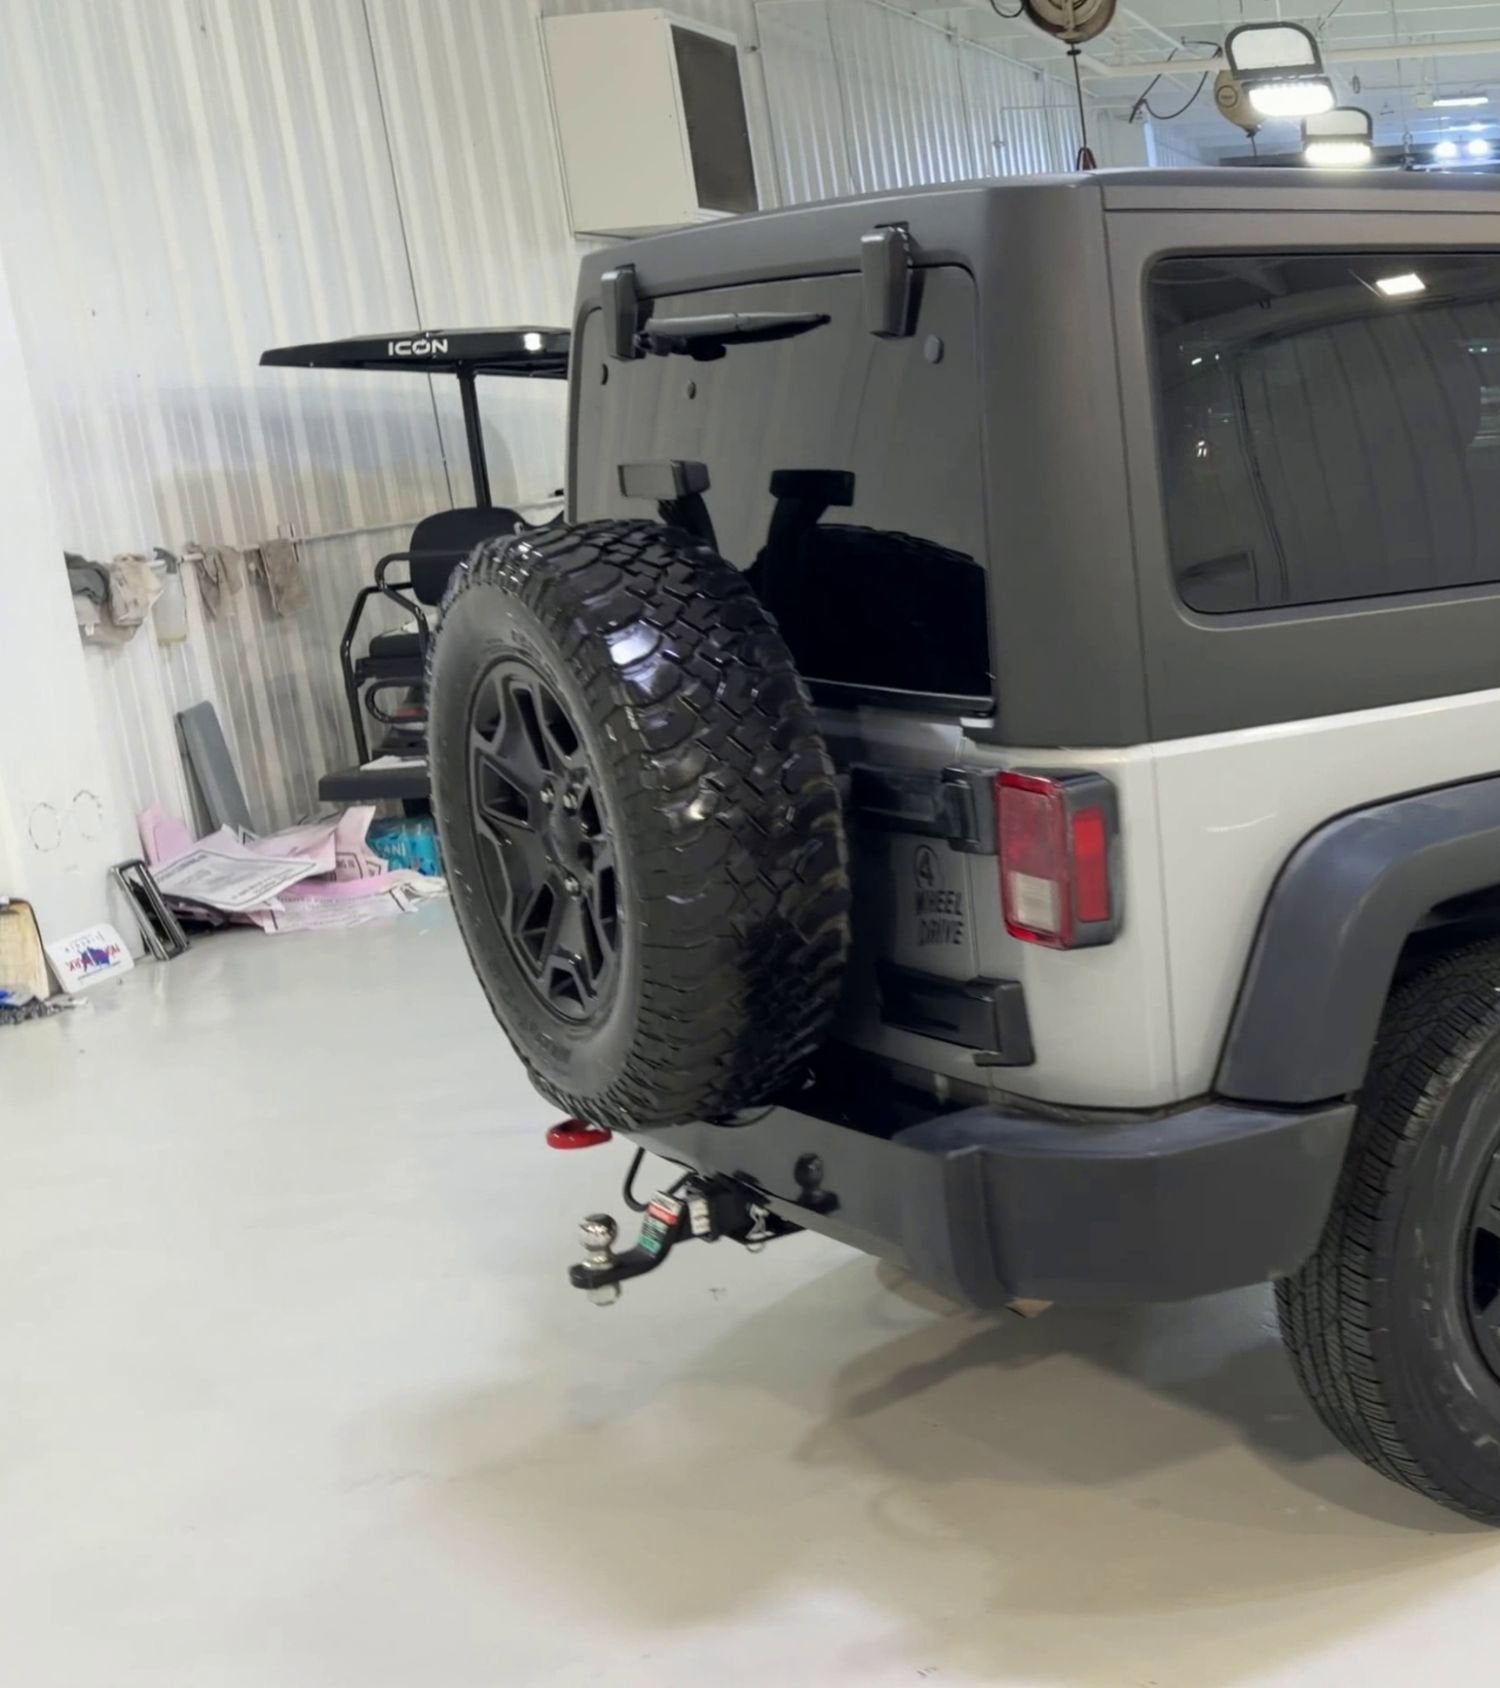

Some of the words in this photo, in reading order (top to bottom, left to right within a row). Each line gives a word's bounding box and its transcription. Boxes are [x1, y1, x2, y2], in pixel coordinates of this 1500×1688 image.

[388, 338, 449, 356] ICON
[915, 889, 963, 917] WHEEL
[918, 918, 964, 947] DRIVE
